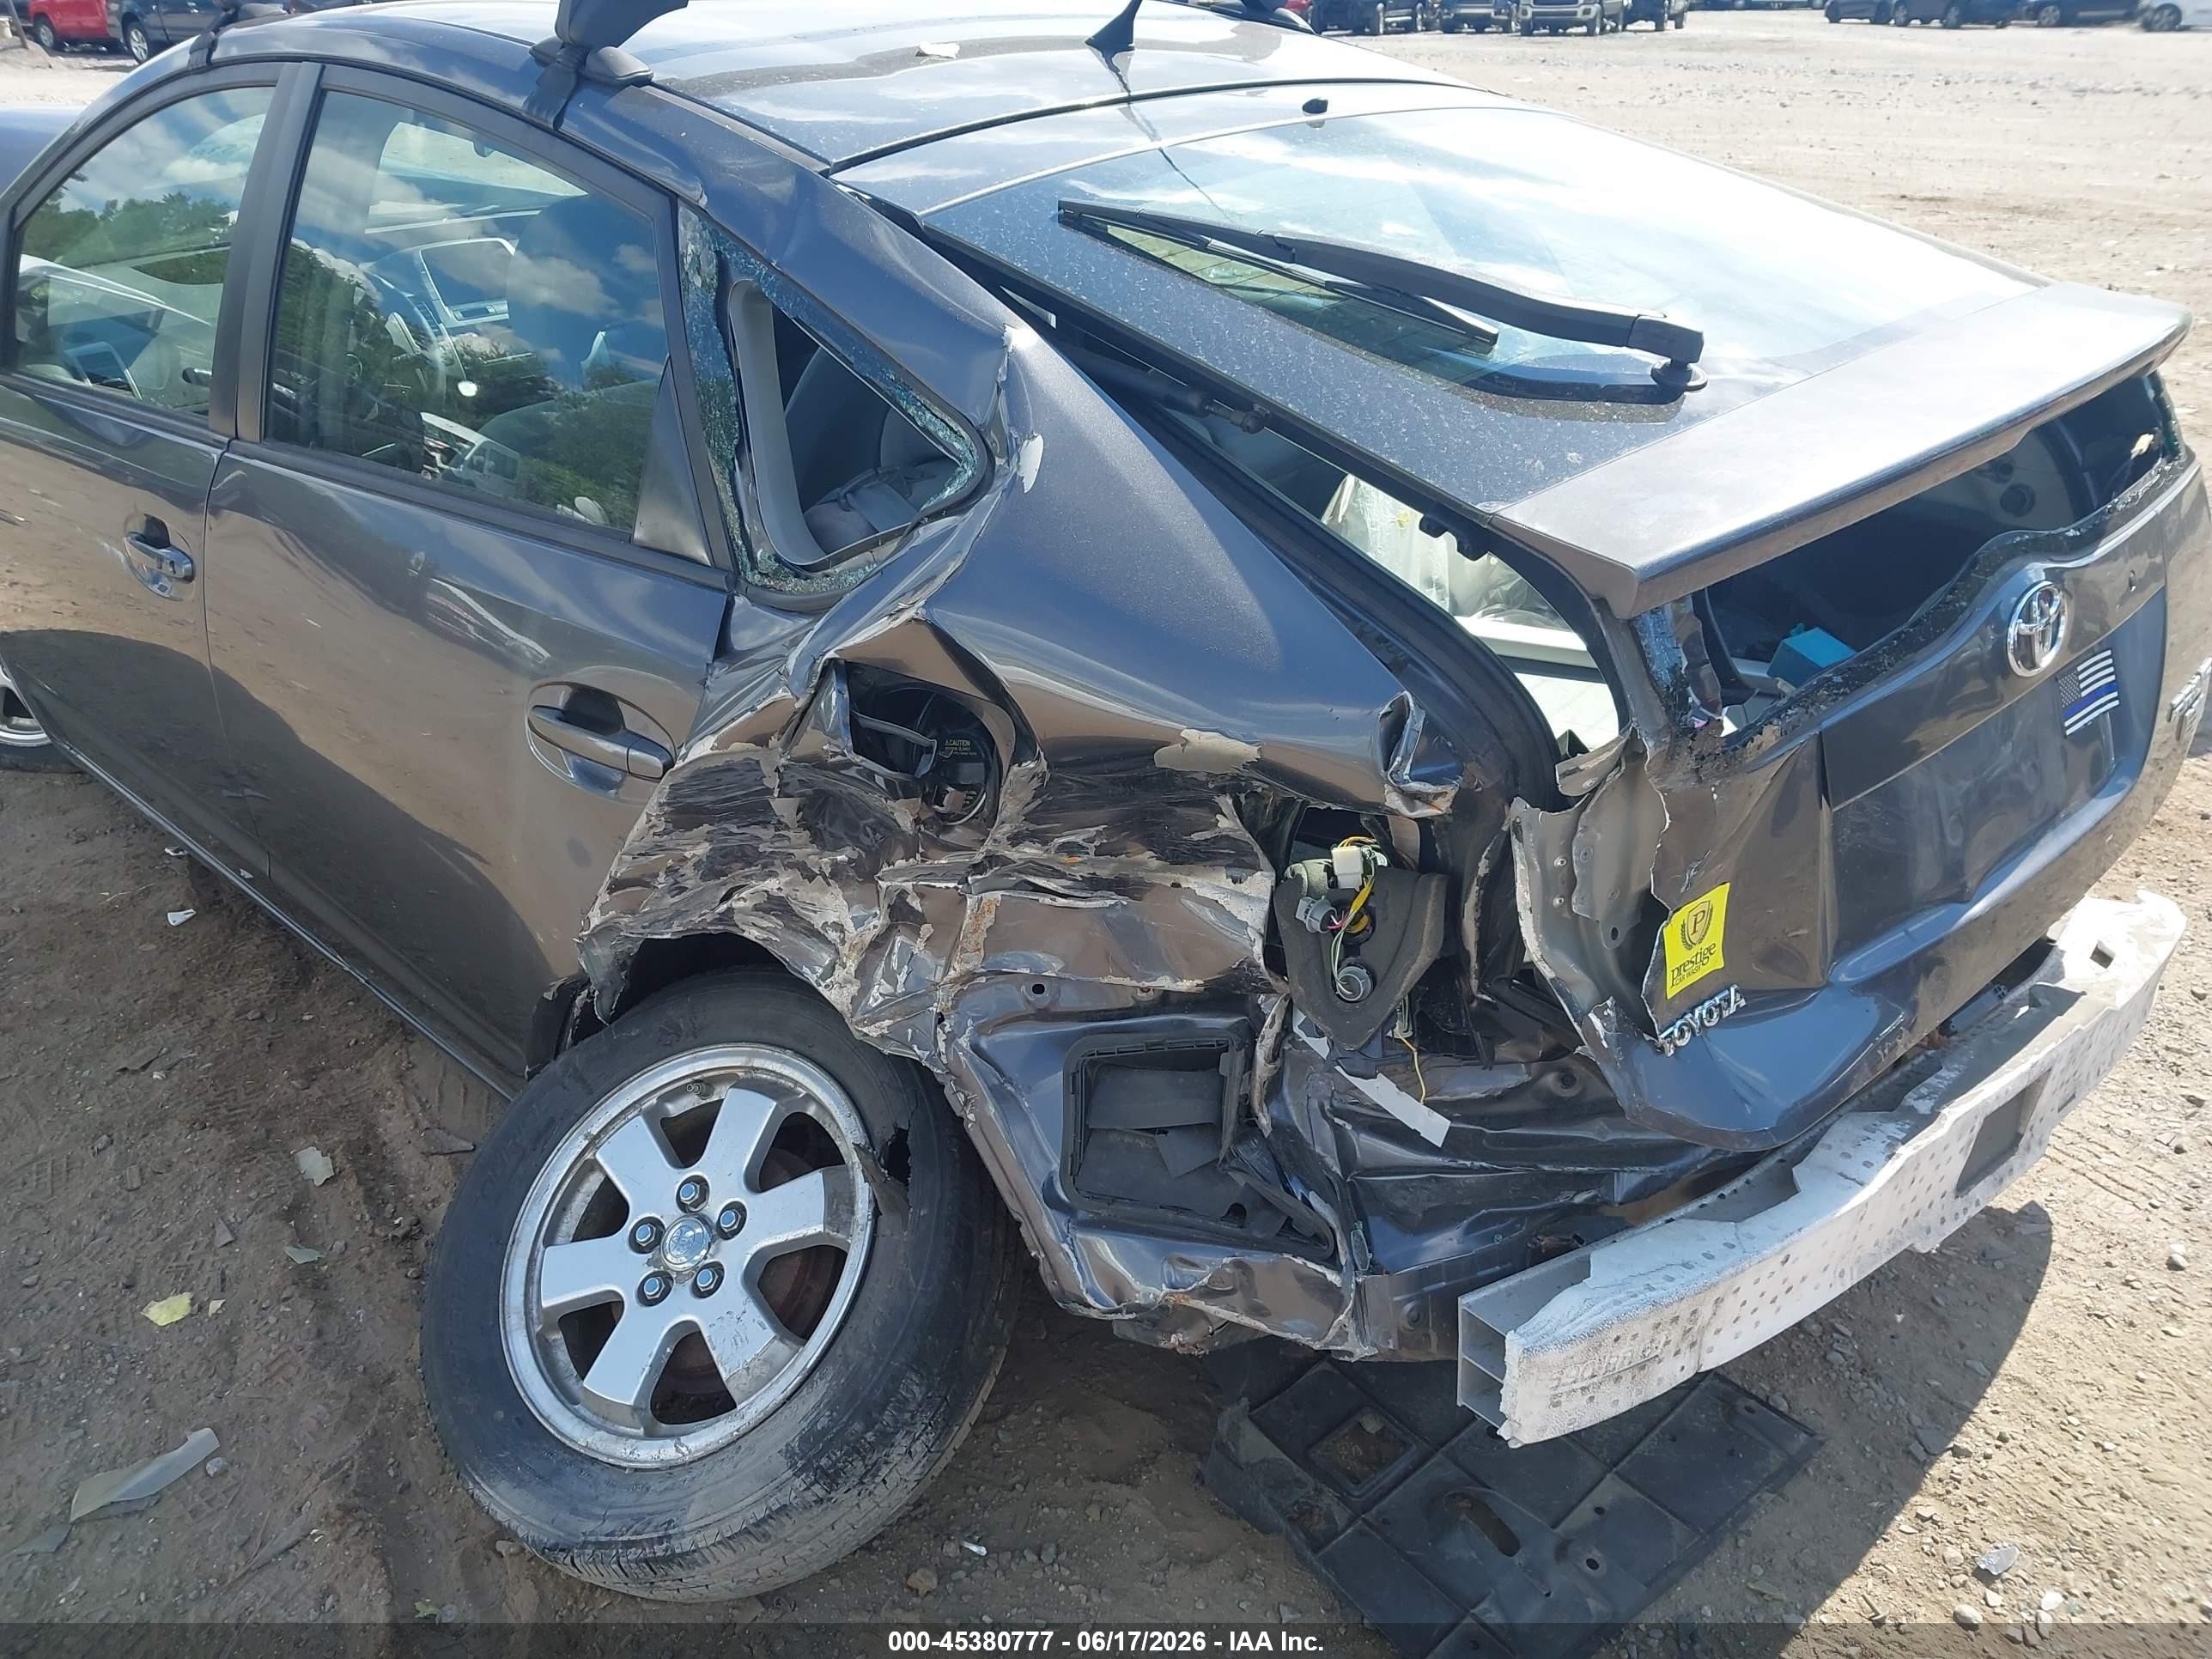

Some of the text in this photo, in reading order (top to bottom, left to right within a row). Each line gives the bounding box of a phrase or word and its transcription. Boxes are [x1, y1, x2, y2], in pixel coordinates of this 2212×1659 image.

[1690, 909, 1706, 937] P
[1670, 943, 1717, 988] prestige
[1675, 963, 1702, 986] CAR WASH
[1659, 984, 1747, 1057] TOYOTA
